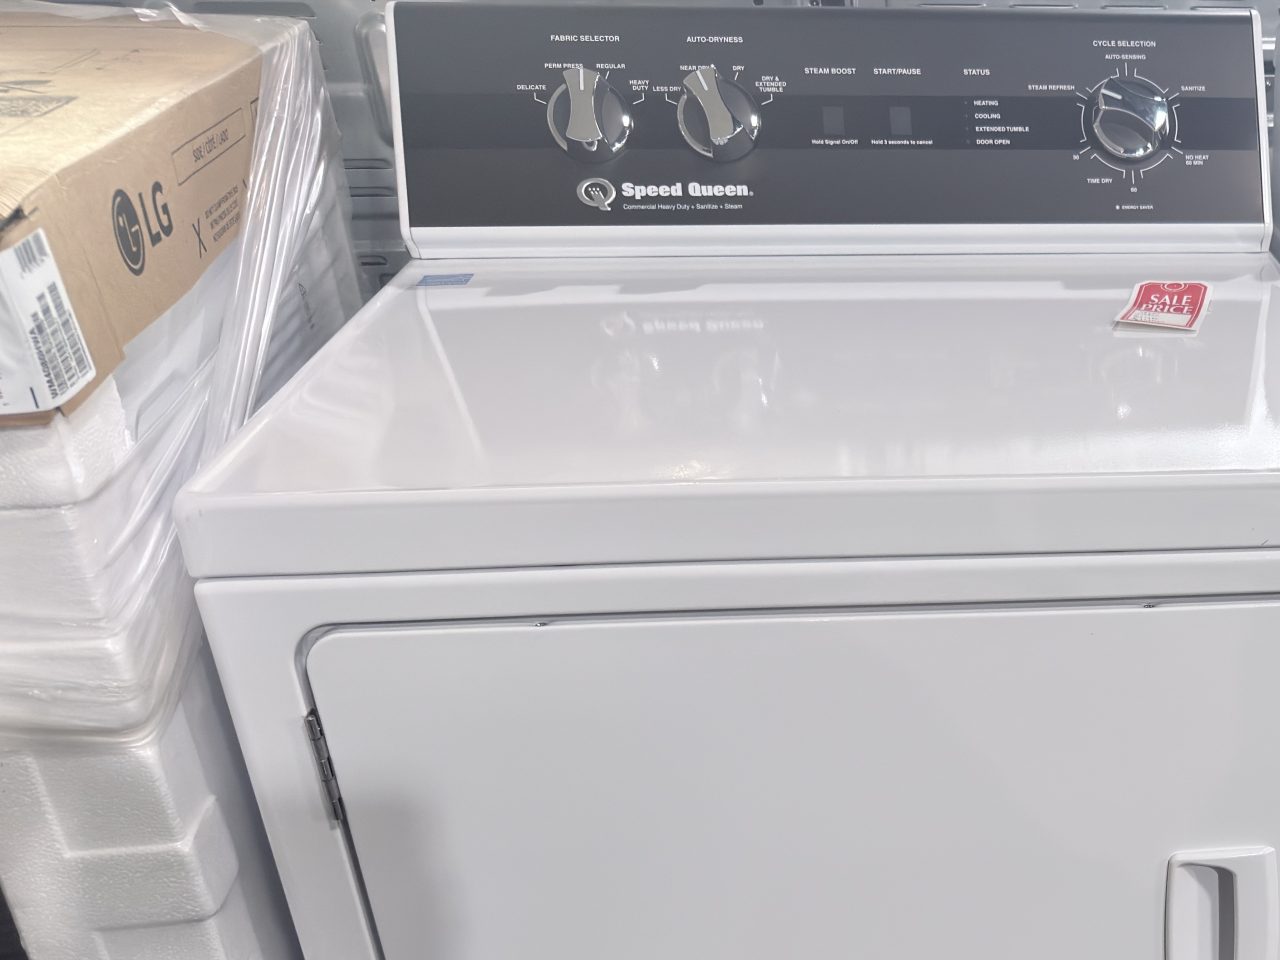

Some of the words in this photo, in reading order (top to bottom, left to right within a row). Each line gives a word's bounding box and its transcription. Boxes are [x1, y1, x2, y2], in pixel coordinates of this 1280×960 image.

[550, 34, 579, 42] FABRIC
[1117, 40, 1156, 48] SELECTION
[621, 182, 683, 200] Speed
[688, 182, 749, 197] Queen
[657, 203, 676, 211] Heavy
[138, 180, 174, 248] LG
[1149, 294, 1192, 306] SALE
[1140, 304, 1194, 314] PRICE
